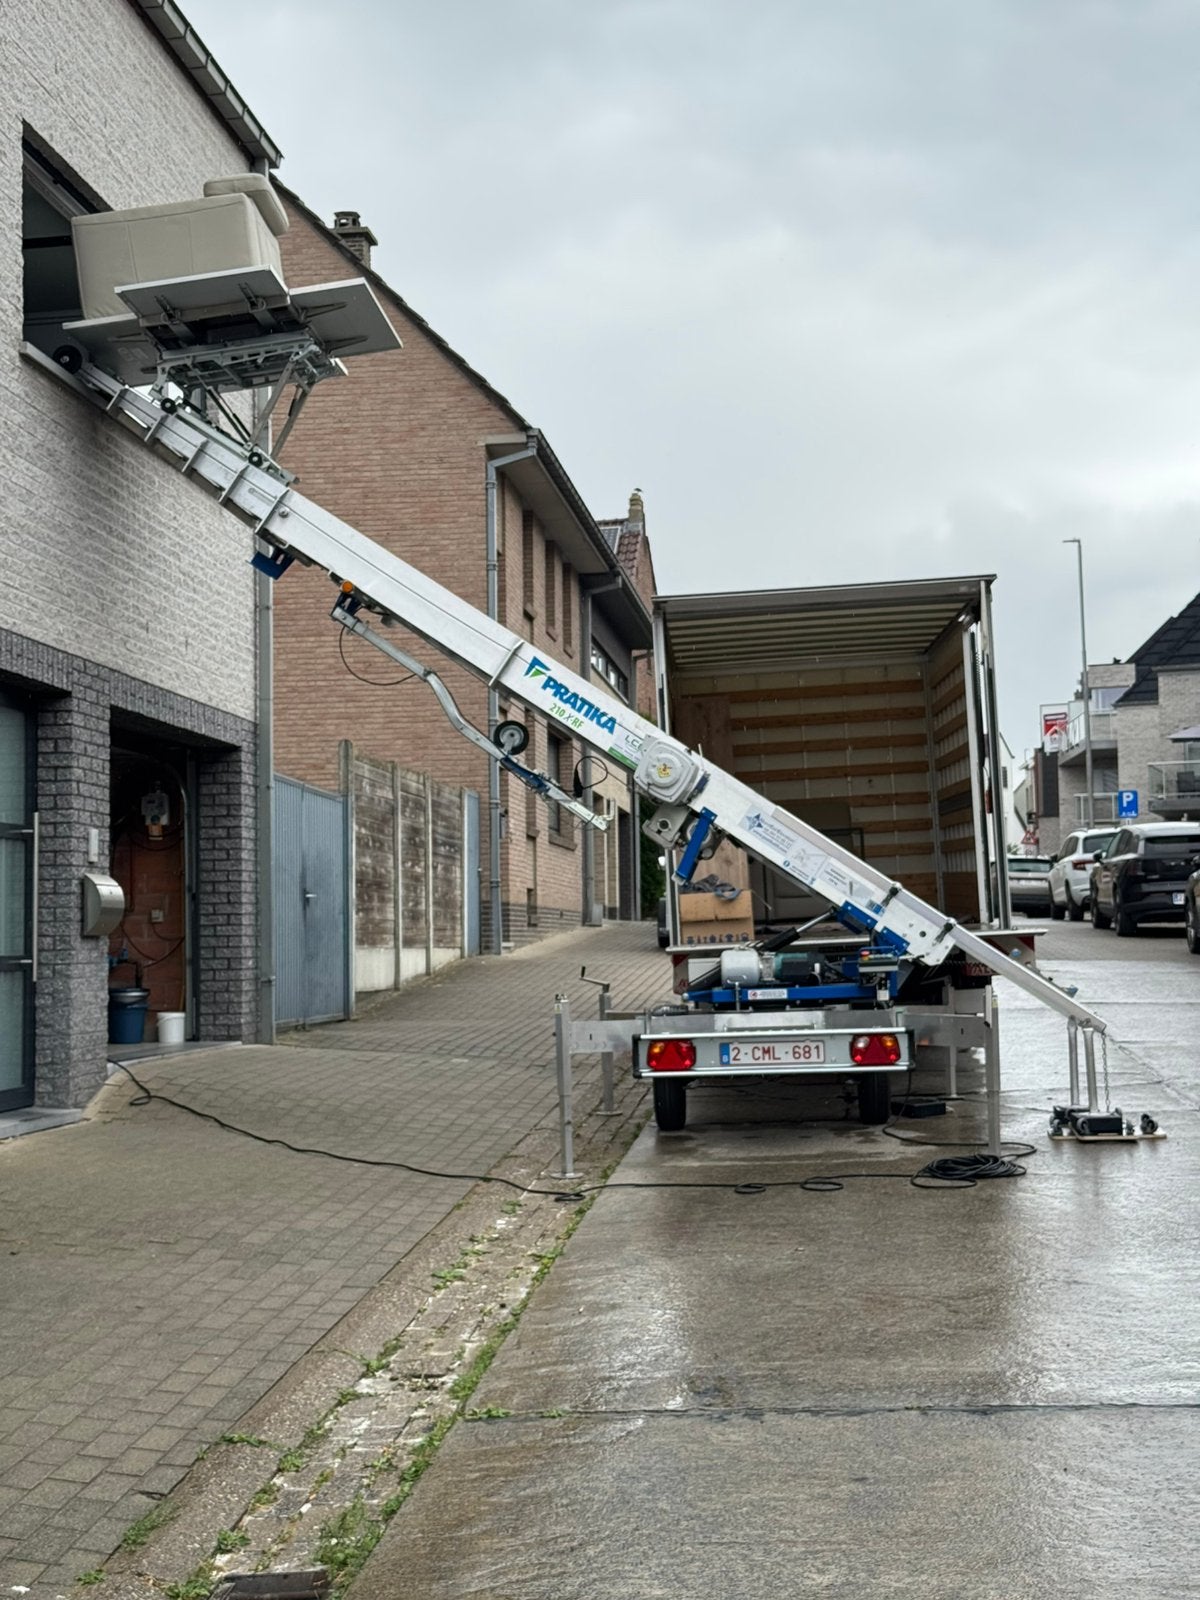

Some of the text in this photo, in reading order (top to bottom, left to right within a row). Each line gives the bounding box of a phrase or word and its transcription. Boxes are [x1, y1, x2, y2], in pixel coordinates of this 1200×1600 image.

[541, 676, 616, 735] PRATIKA
[549, 703, 565, 718] 210
[1122, 792, 1134, 808] P
[731, 1045, 820, 1062] 2-CML-681
